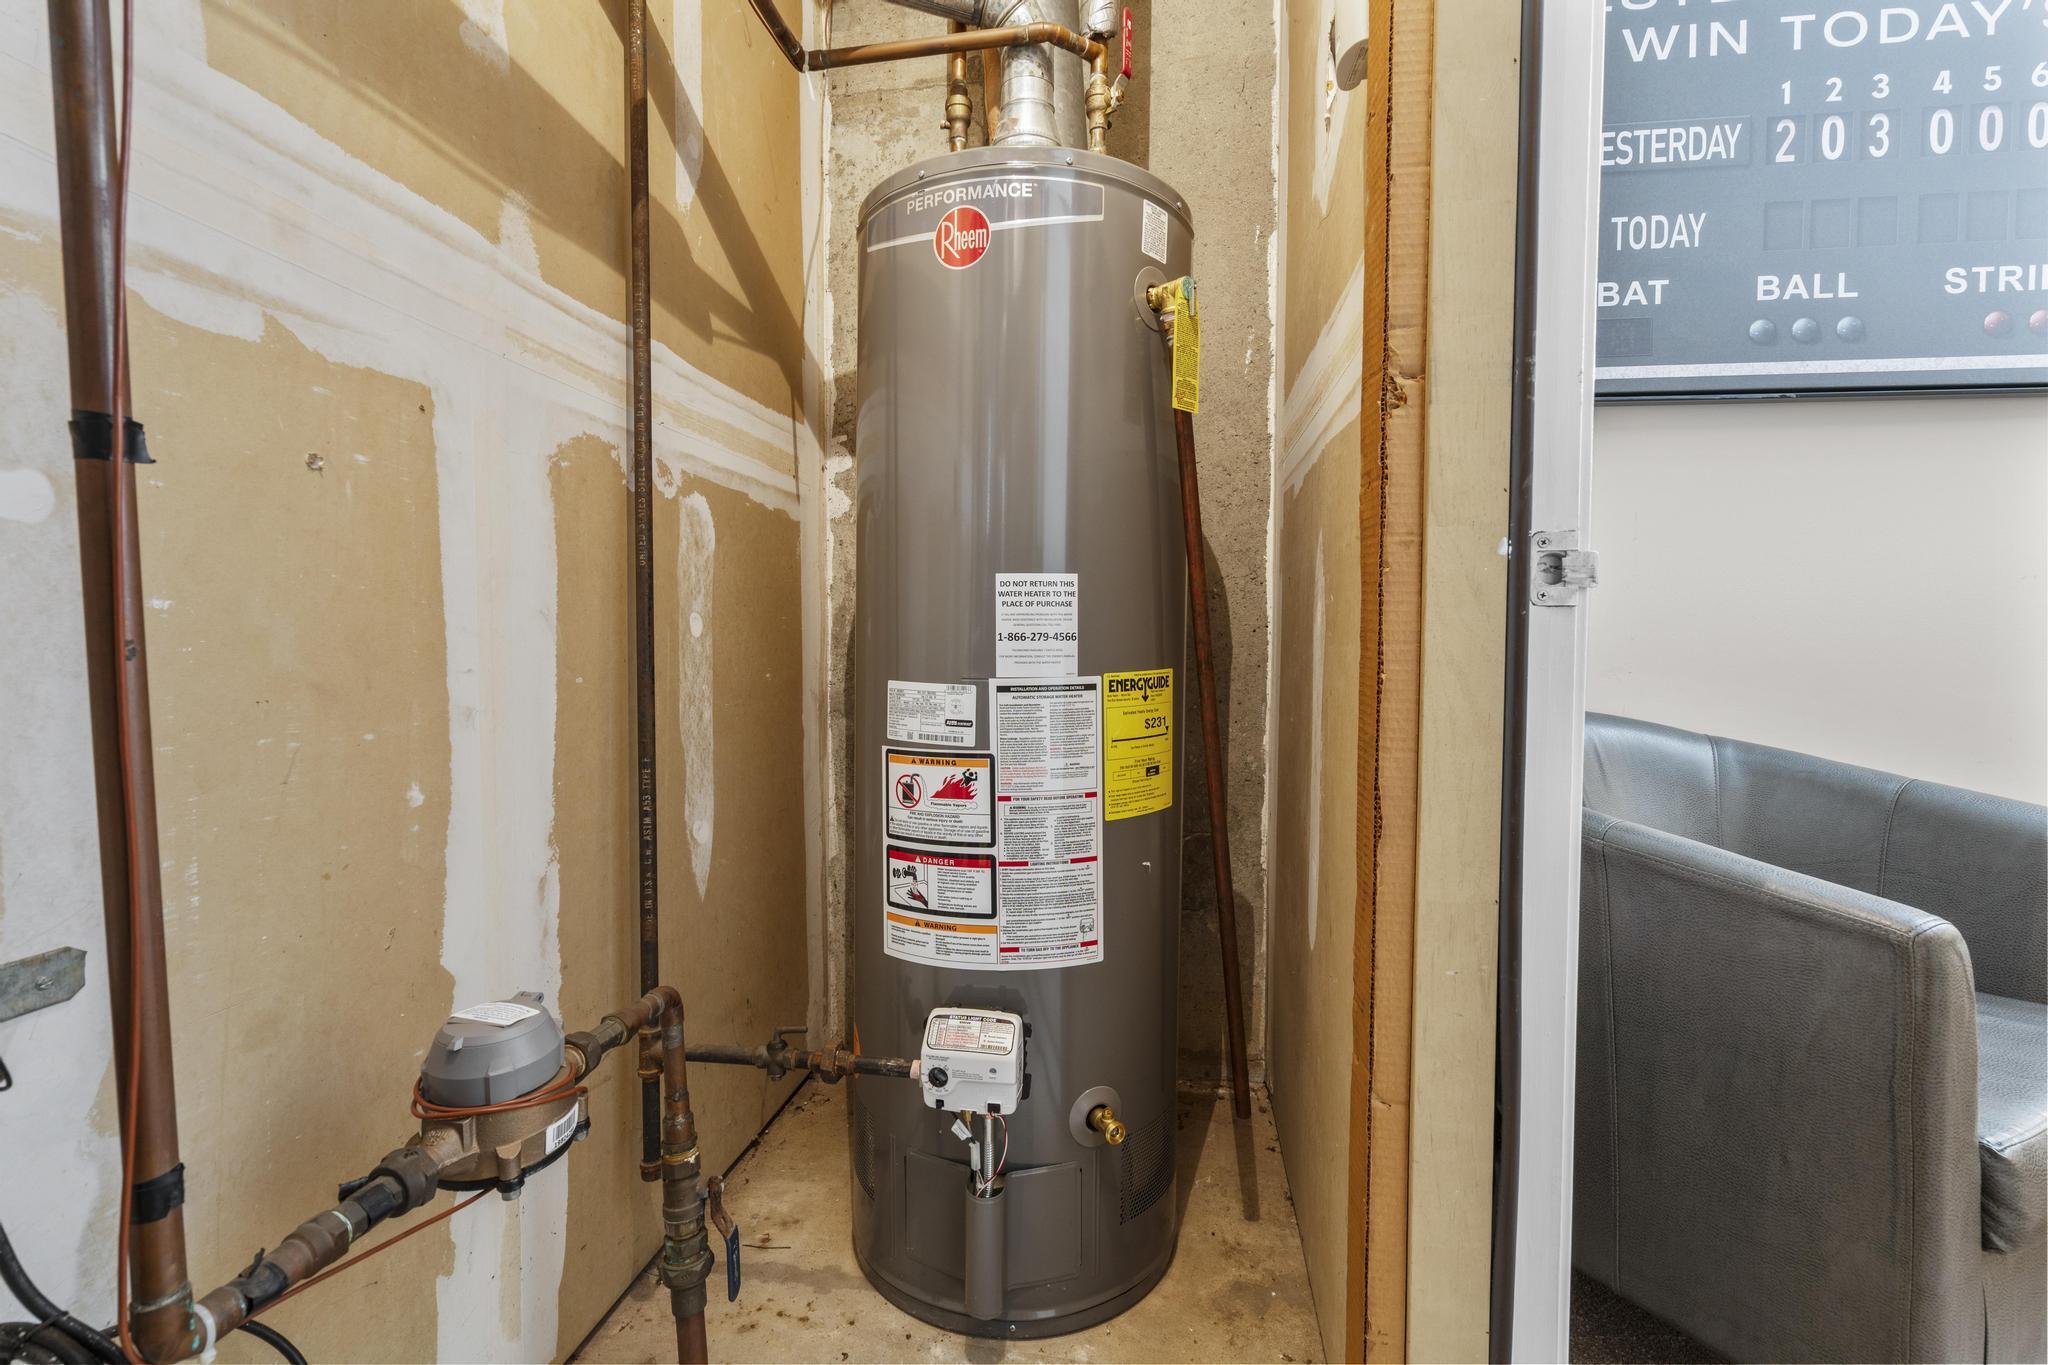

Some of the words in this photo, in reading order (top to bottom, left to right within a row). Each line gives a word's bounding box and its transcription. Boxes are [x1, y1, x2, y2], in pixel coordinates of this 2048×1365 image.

[1622, 20, 1747, 62] WIN
[1780, 0, 2048, 50] TODAY'
[1781, 80, 1791, 105] 1
[1825, 77, 1843, 102] 2
[1871, 73, 1890, 99] 3
[1932, 70, 1953, 94] 4
[1983, 65, 2002, 91] 5
[2031, 61, 2048, 87] 6
[1600, 123, 1742, 166] ESTERDAY
[1775, 119, 1796, 163] 2
[1821, 115, 1845, 160] 0
[1868, 113, 1890, 158] 3
[1929, 108, 1954, 154] 0
[1978, 105, 2004, 151] 0
[906, 182, 1033, 215] PERFORMANCE
[941, 209, 987, 259] Rheem
[1611, 212, 1707, 251] TODAY
[1597, 279, 1670, 307] BAT
[1756, 272, 1859, 301] BALL
[997, 632, 1077, 641] 1-866-279-4566
[1108, 675, 1170, 693] ENERGYGUIDE
[1144, 716, 1166, 729] $231
[919, 757, 957, 766] WARNING
[922, 857, 955, 866] DANGER
[924, 921, 957, 931] WARNING
